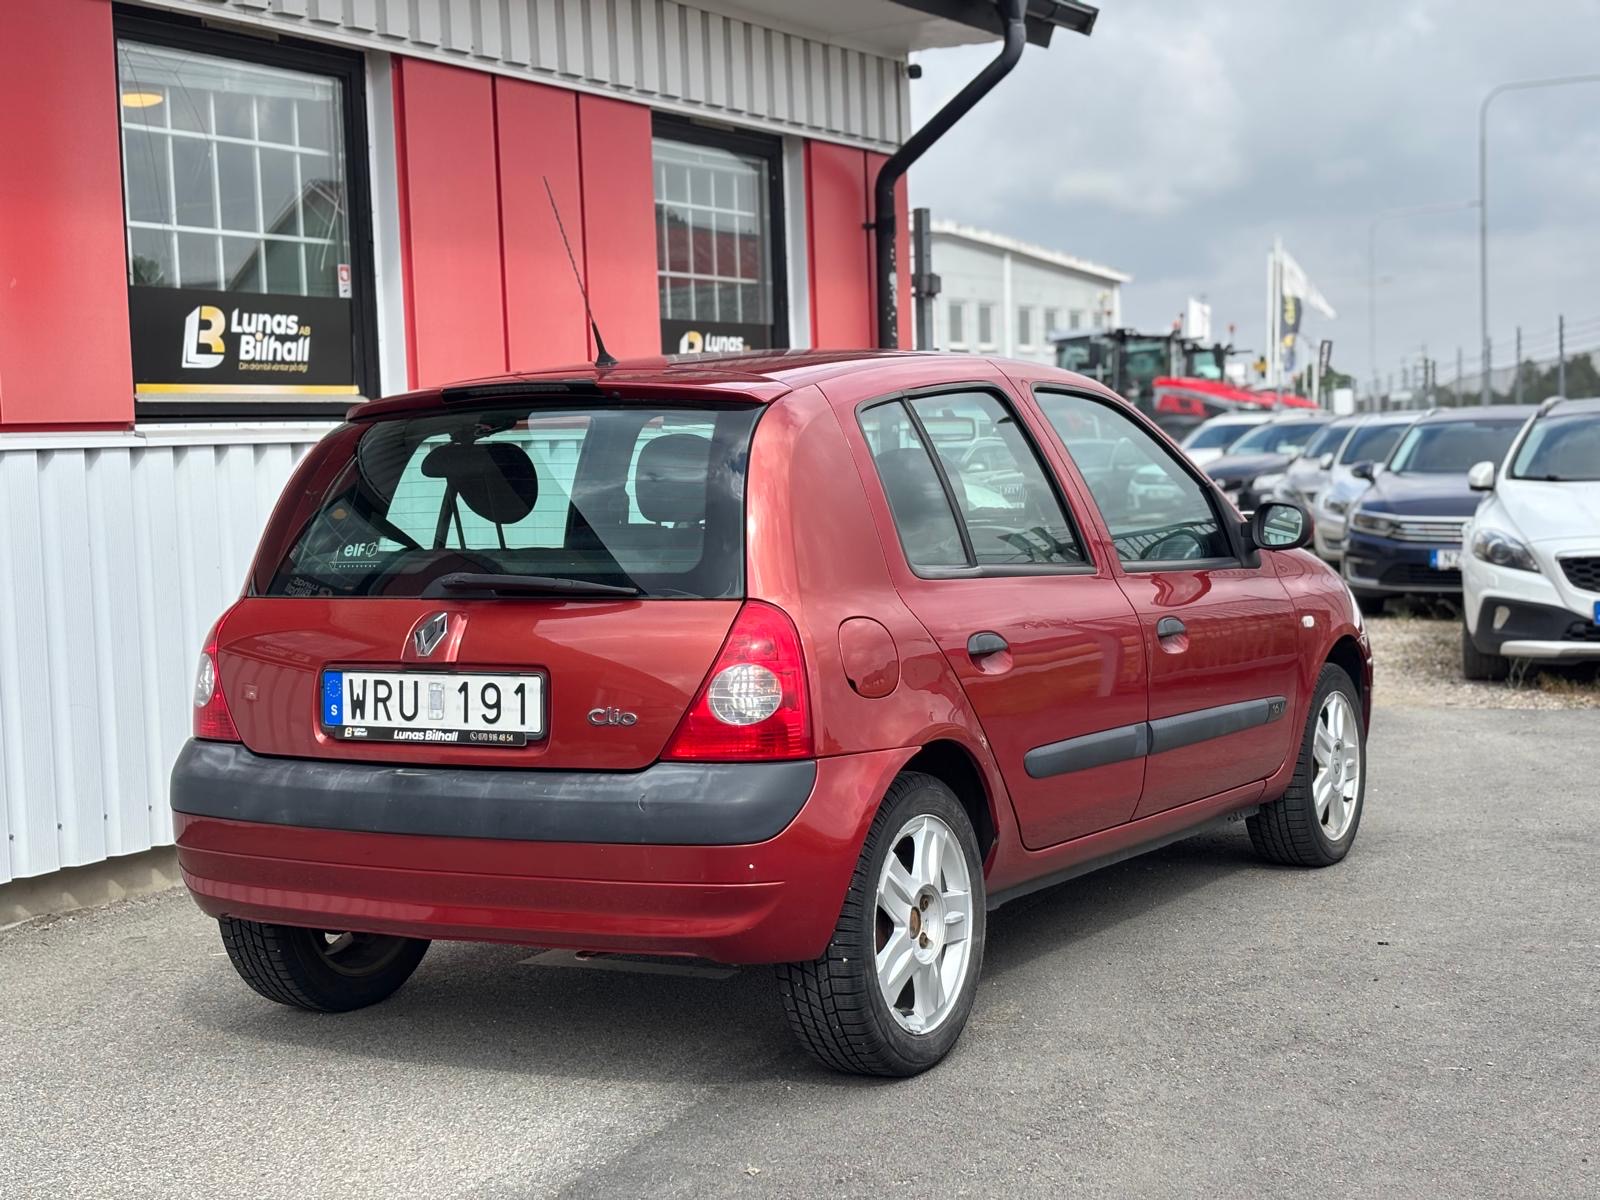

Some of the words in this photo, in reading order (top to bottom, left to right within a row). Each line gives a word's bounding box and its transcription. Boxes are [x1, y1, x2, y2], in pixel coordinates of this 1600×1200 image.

[231, 308, 299, 335] Lunas
[298, 325, 311, 336] AB
[239, 333, 311, 361] Bilhall
[704, 332, 744, 353] Lunas
[344, 543, 366, 557] elf
[330, 704, 338, 716] S
[348, 679, 419, 722] WRU
[457, 681, 526, 726] 191
[587, 706, 638, 726] Clio
[393, 729, 425, 740] Lunas
[425, 729, 459, 742] Bilhall
